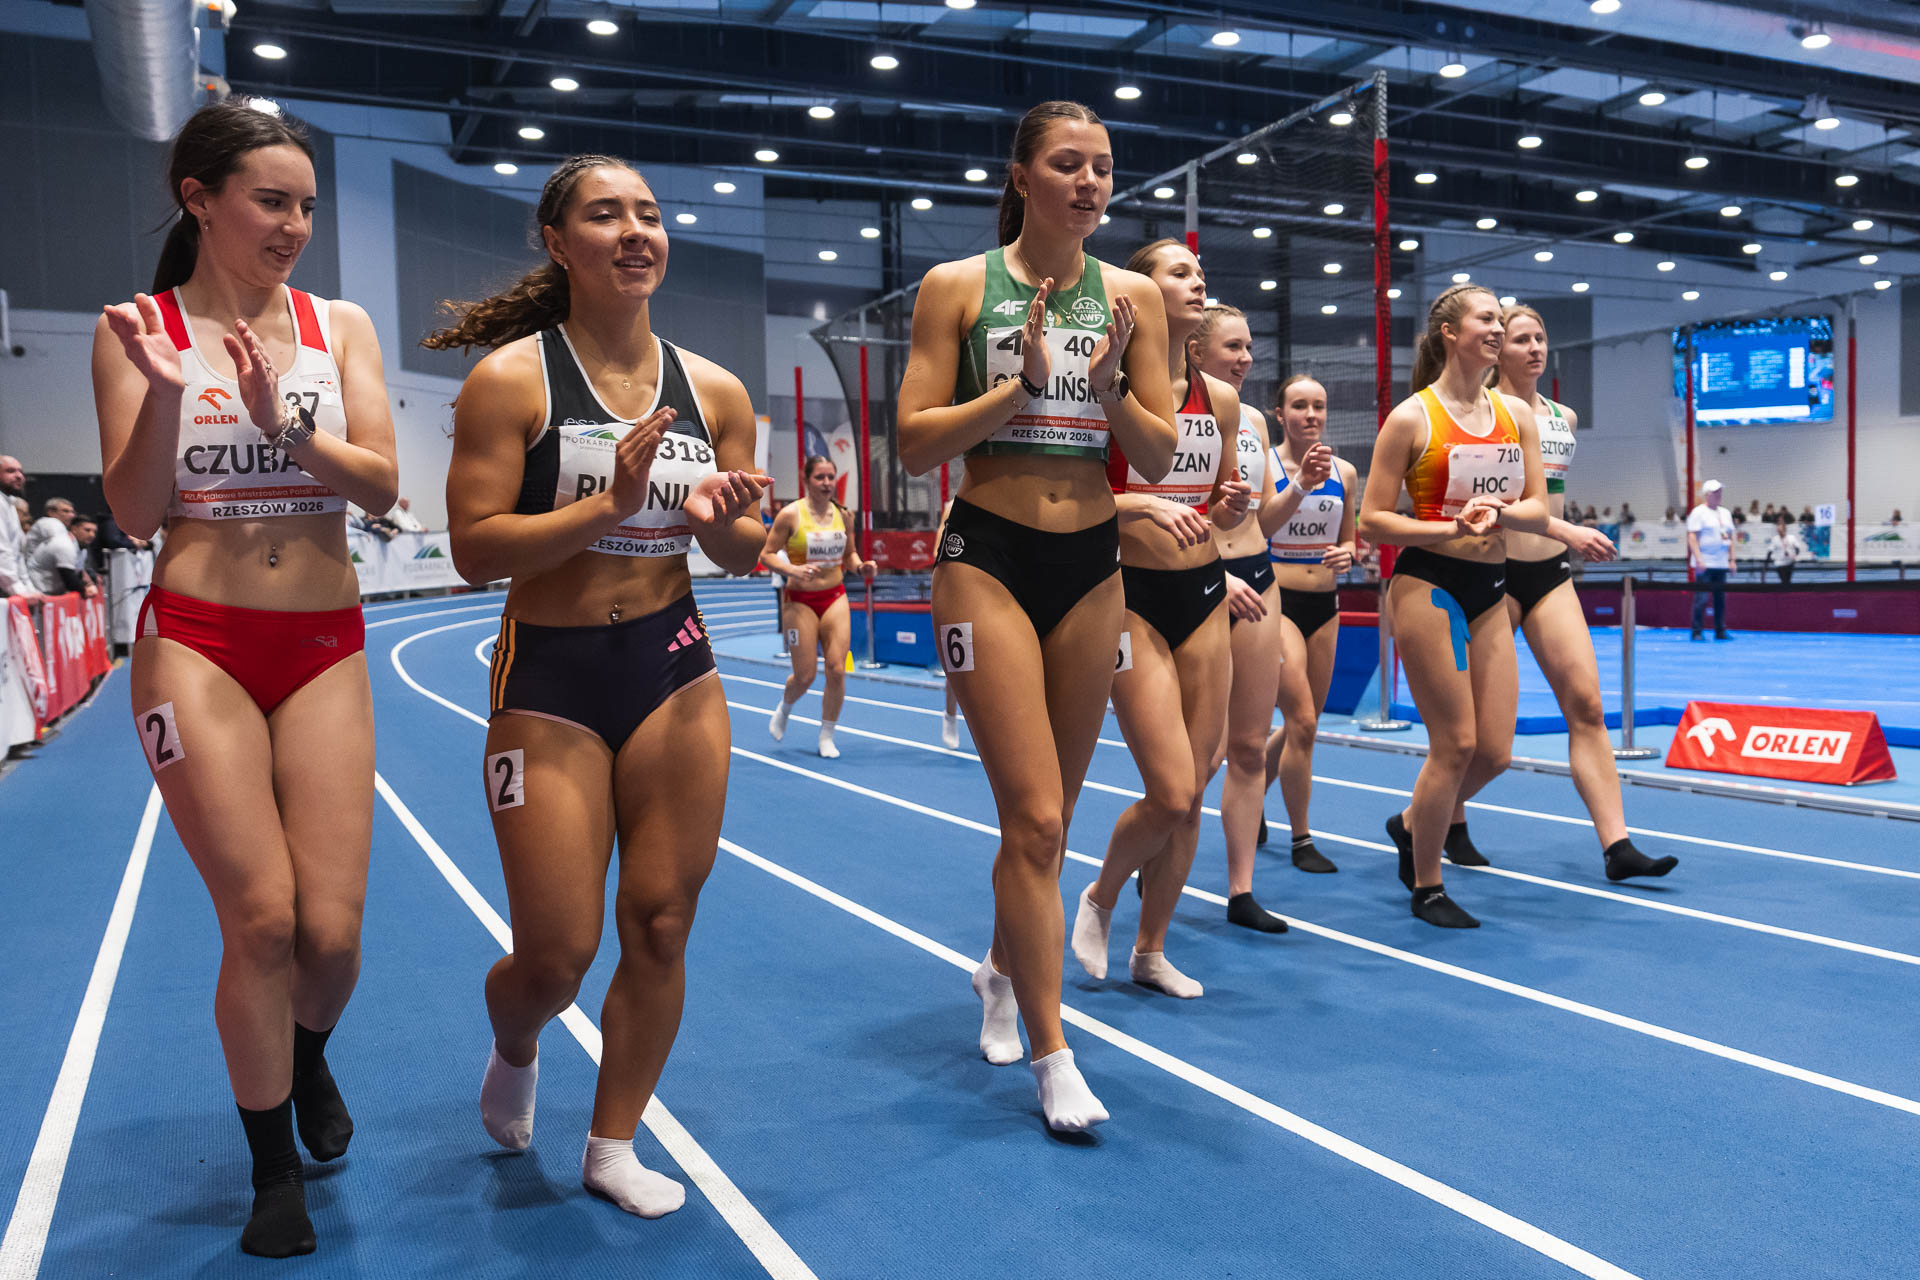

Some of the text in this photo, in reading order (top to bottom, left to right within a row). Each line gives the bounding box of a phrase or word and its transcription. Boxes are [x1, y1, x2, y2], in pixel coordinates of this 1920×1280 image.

[1078, 302, 1097, 310] AZS
[1080, 313, 1101, 322] AWF
[194, 414, 238, 425] ORLEN
[1011, 428, 1093, 442] RZESZÓW 2026
[1184, 419, 1215, 437] 718
[653, 437, 712, 464] 318
[1497, 448, 1520, 463] 710
[1541, 440, 1575, 456] SZTORT
[1173, 452, 1211, 473] ZAN
[1472, 476, 1509, 494] HOC
[212, 500, 324, 518] RZESZÓW 2026
[1319, 500, 1334, 512] 67
[1820, 506, 1833, 519] 16
[1288, 522, 1328, 536] KŁOK
[650, 542, 675, 554] 2026
[946, 627, 966, 669] 6
[145, 712, 175, 765] 2
[1751, 732, 1841, 757] ORLEN
[495, 756, 515, 806] 2
